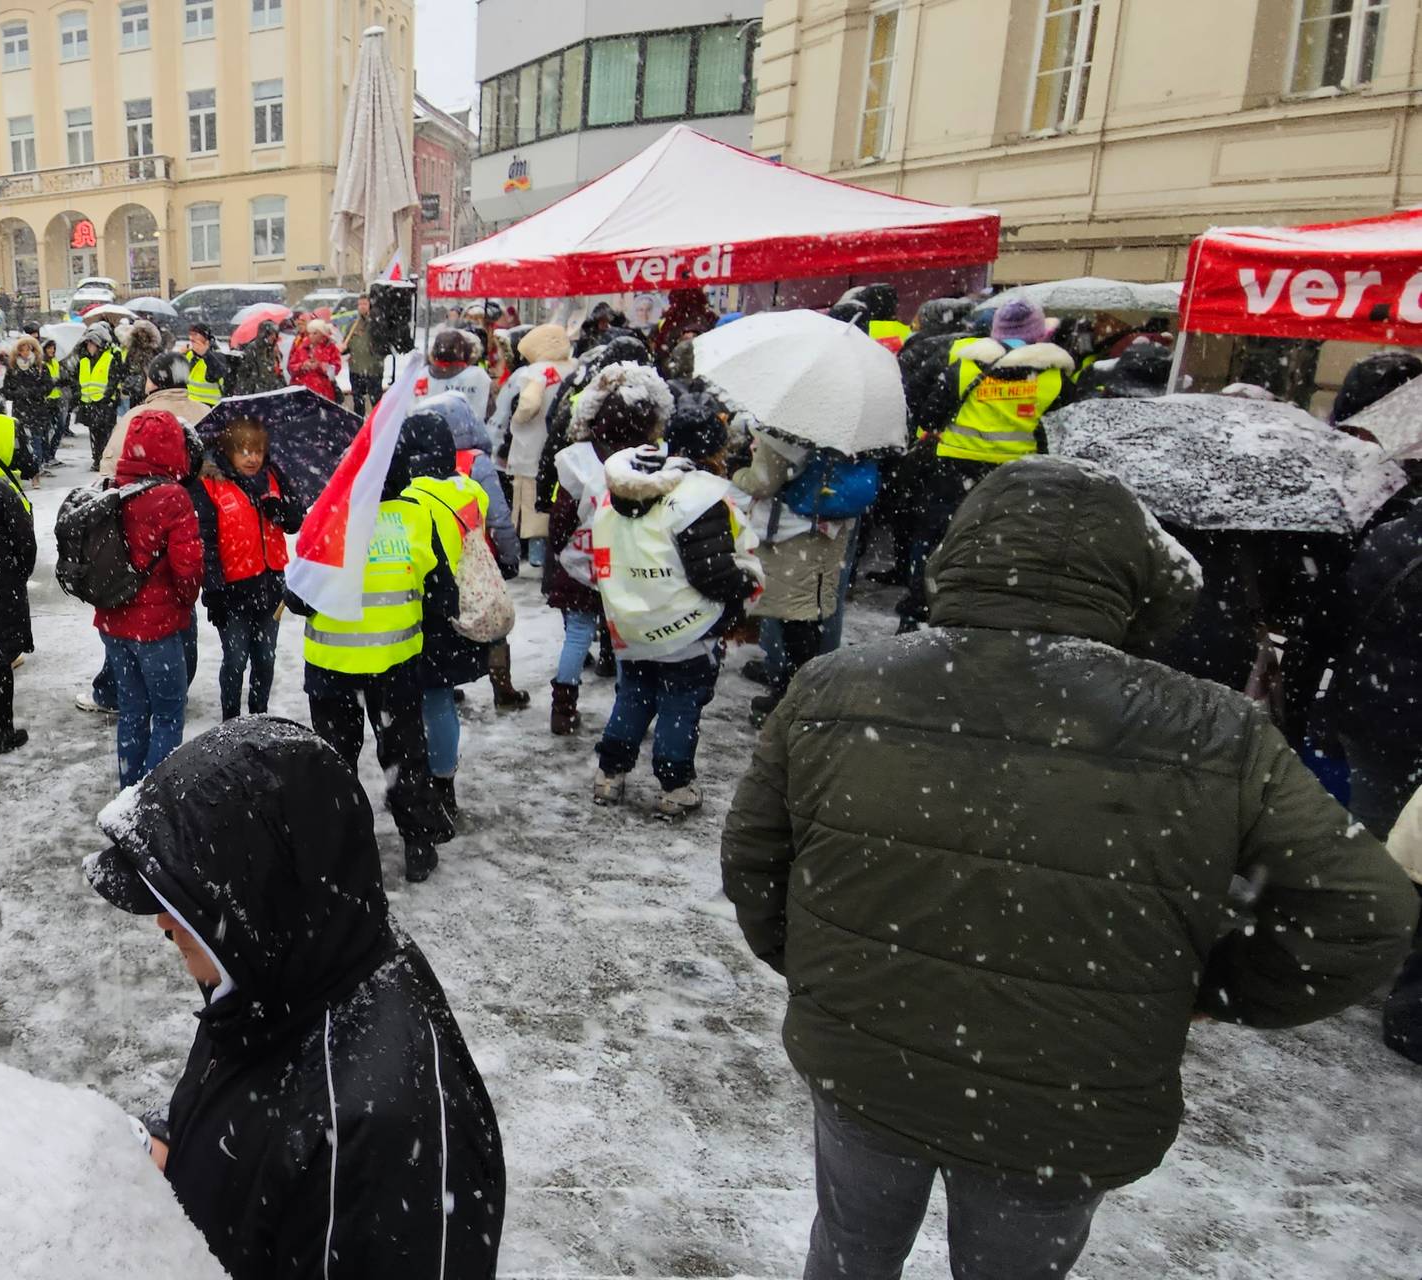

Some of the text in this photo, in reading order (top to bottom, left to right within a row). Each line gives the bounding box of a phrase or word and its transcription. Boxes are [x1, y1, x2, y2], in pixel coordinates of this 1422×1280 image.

[508, 155, 527, 179] dm
[616, 244, 734, 284] ver.di
[367, 538, 410, 556] MEHR
[645, 609, 702, 642] STREIK
